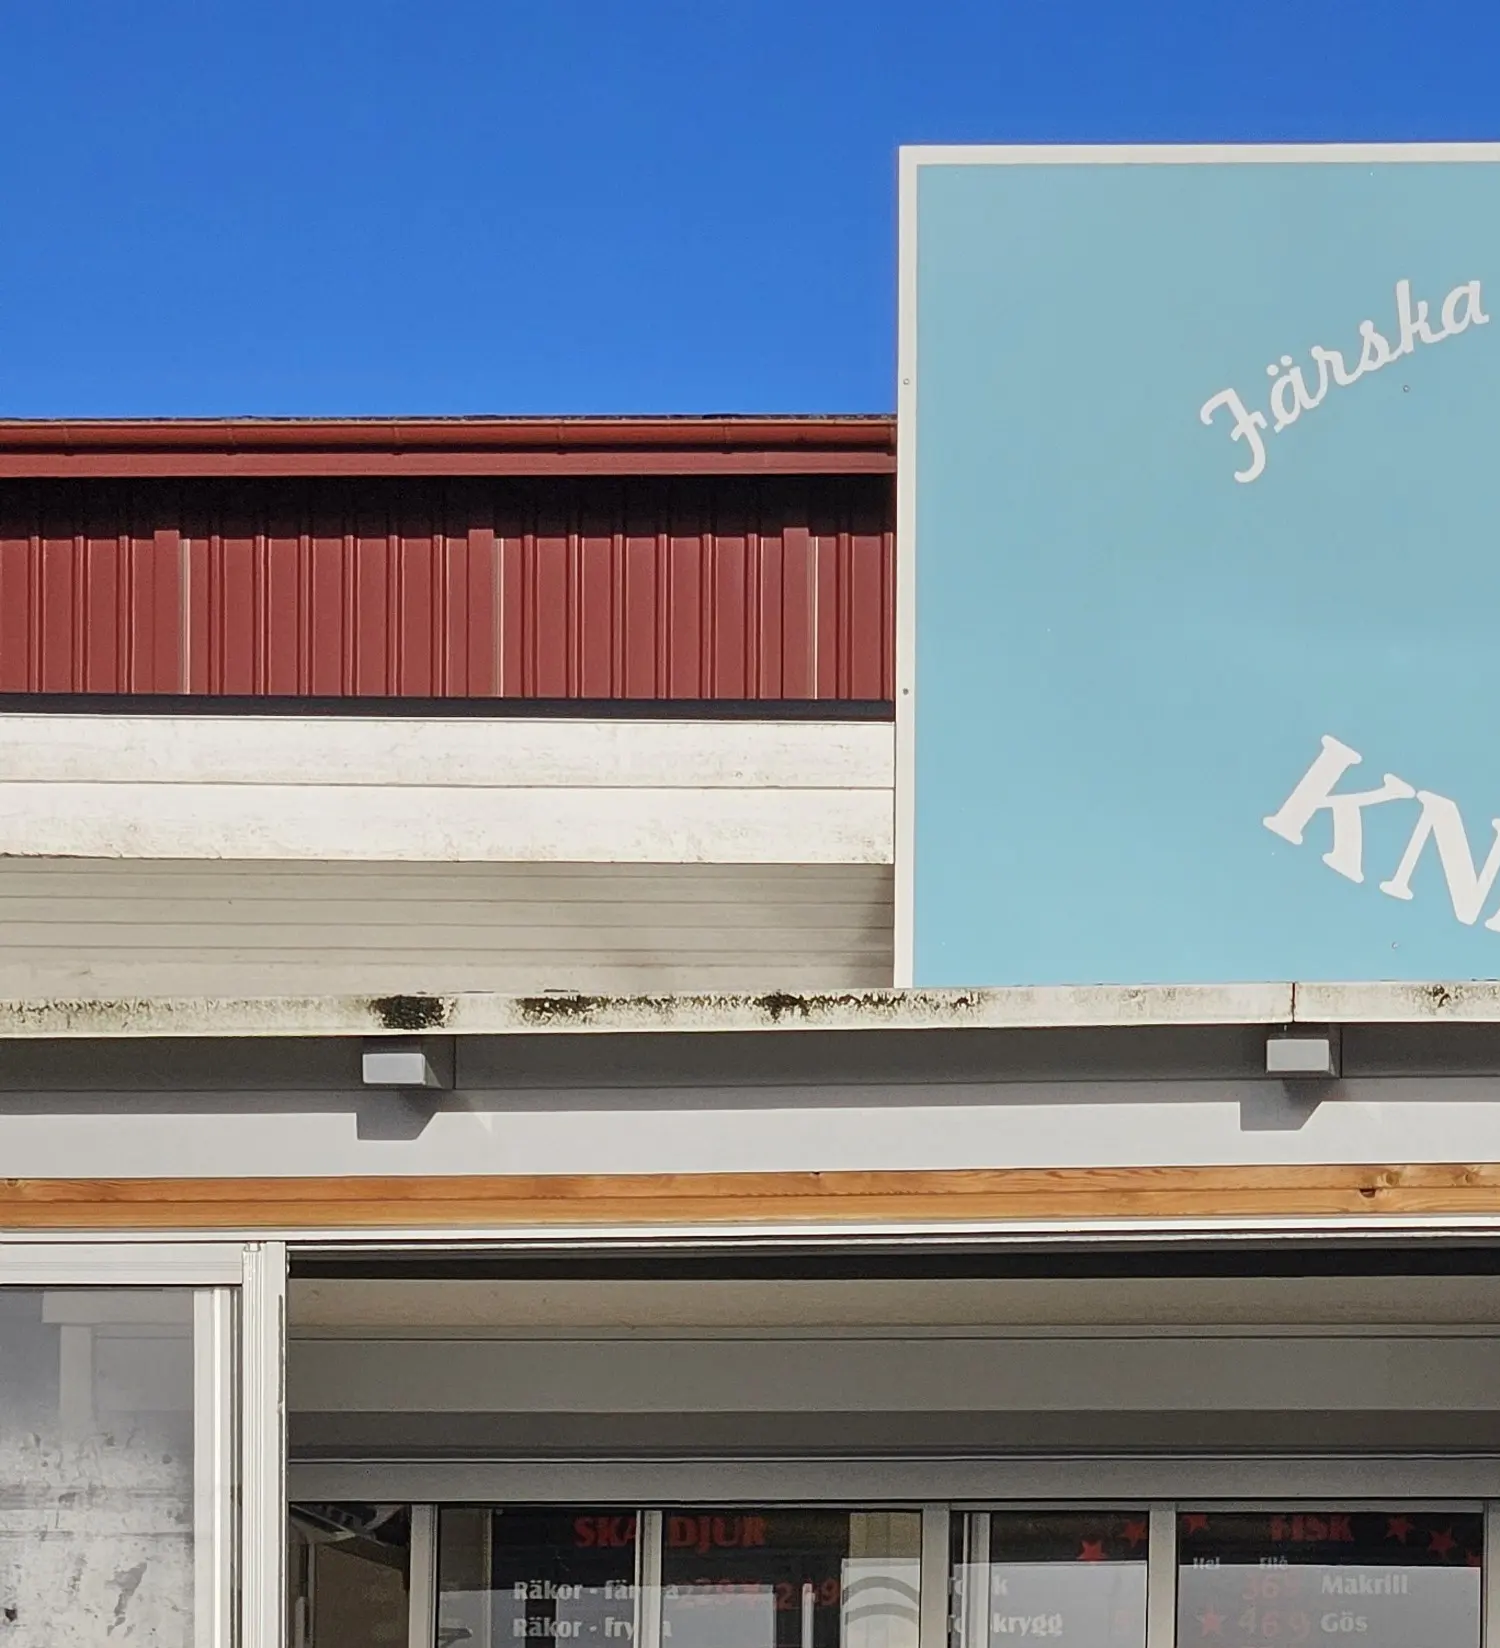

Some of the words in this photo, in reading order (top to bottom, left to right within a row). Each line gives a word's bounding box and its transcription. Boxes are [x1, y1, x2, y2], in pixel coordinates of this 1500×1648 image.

[1199, 279, 1490, 483] Färska
[513, 1579, 583, 1600] Räkor
[1321, 1574, 1408, 1595] Makrill
[513, 1617, 582, 1637] Räkor
[1320, 1611, 1368, 1632] Gös
